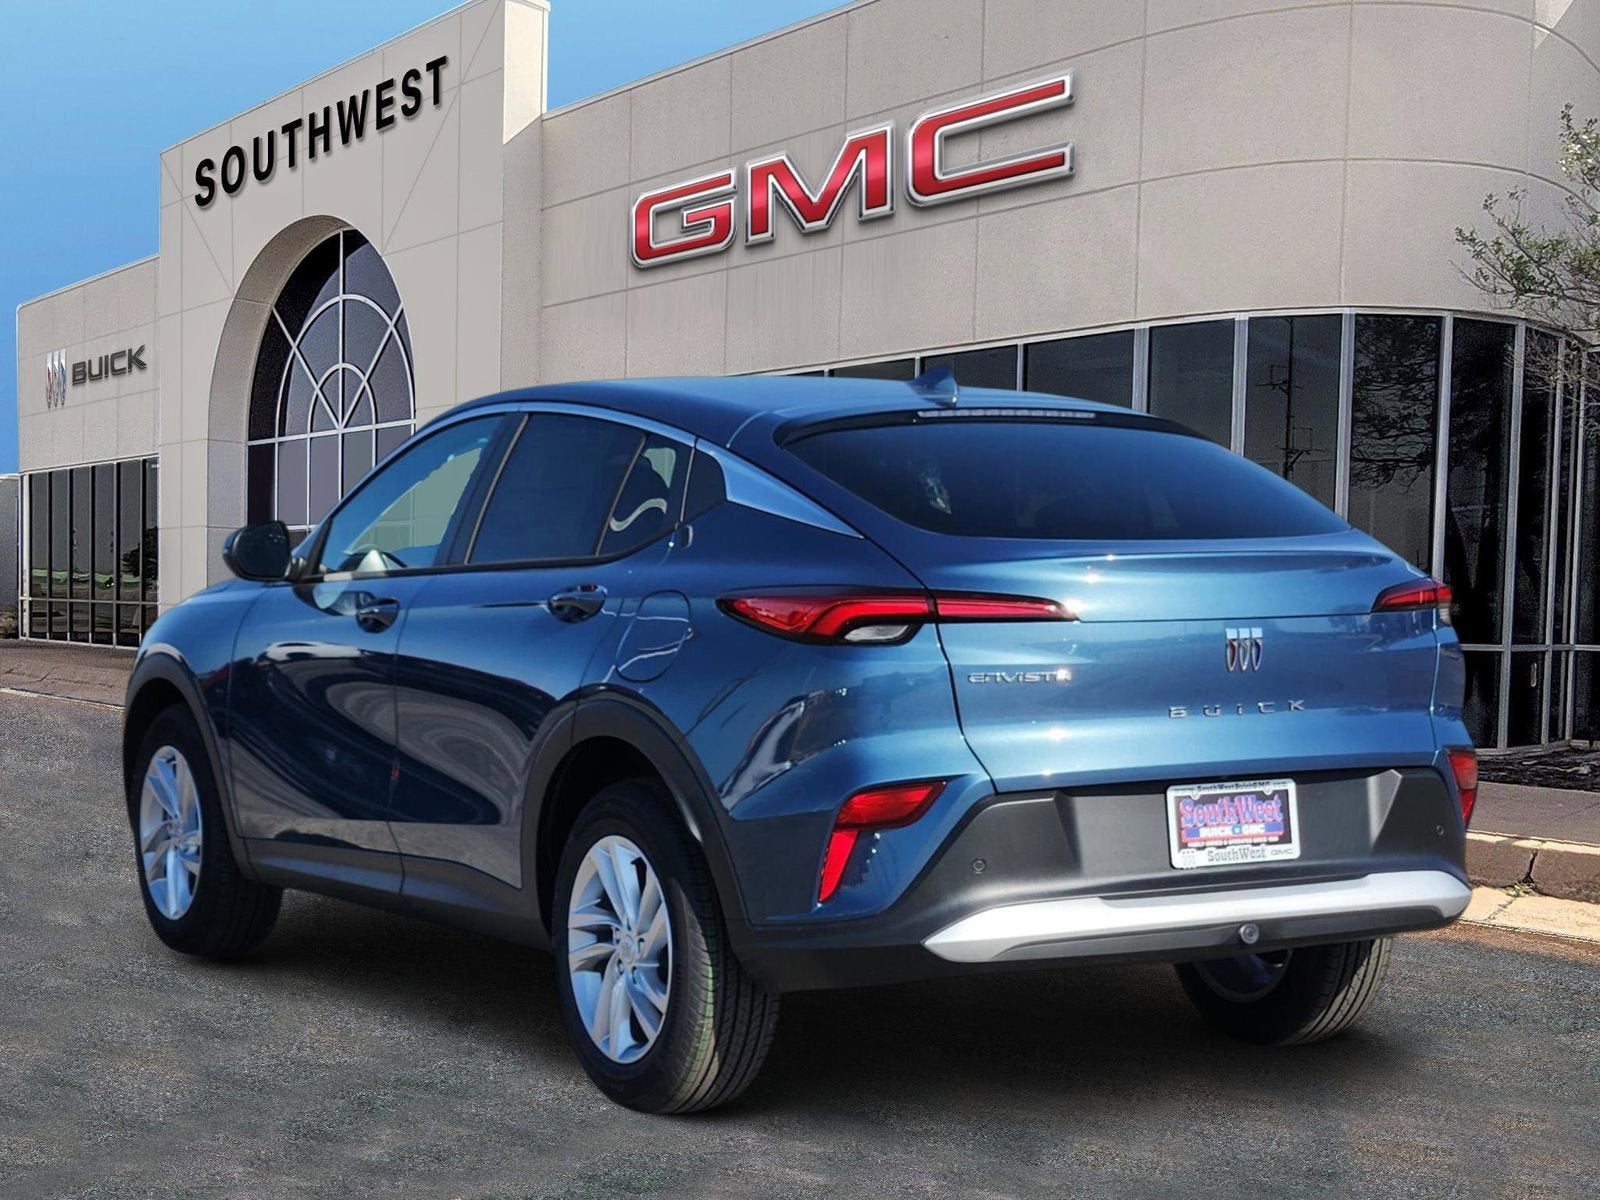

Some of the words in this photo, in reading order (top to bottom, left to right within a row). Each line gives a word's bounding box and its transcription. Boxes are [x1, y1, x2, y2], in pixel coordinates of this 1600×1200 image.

[195, 55, 448, 207] SOUTHWEST
[631, 69, 1075, 267] GMC
[72, 344, 147, 385] BUICK
[1168, 699, 1305, 719] BUICK
